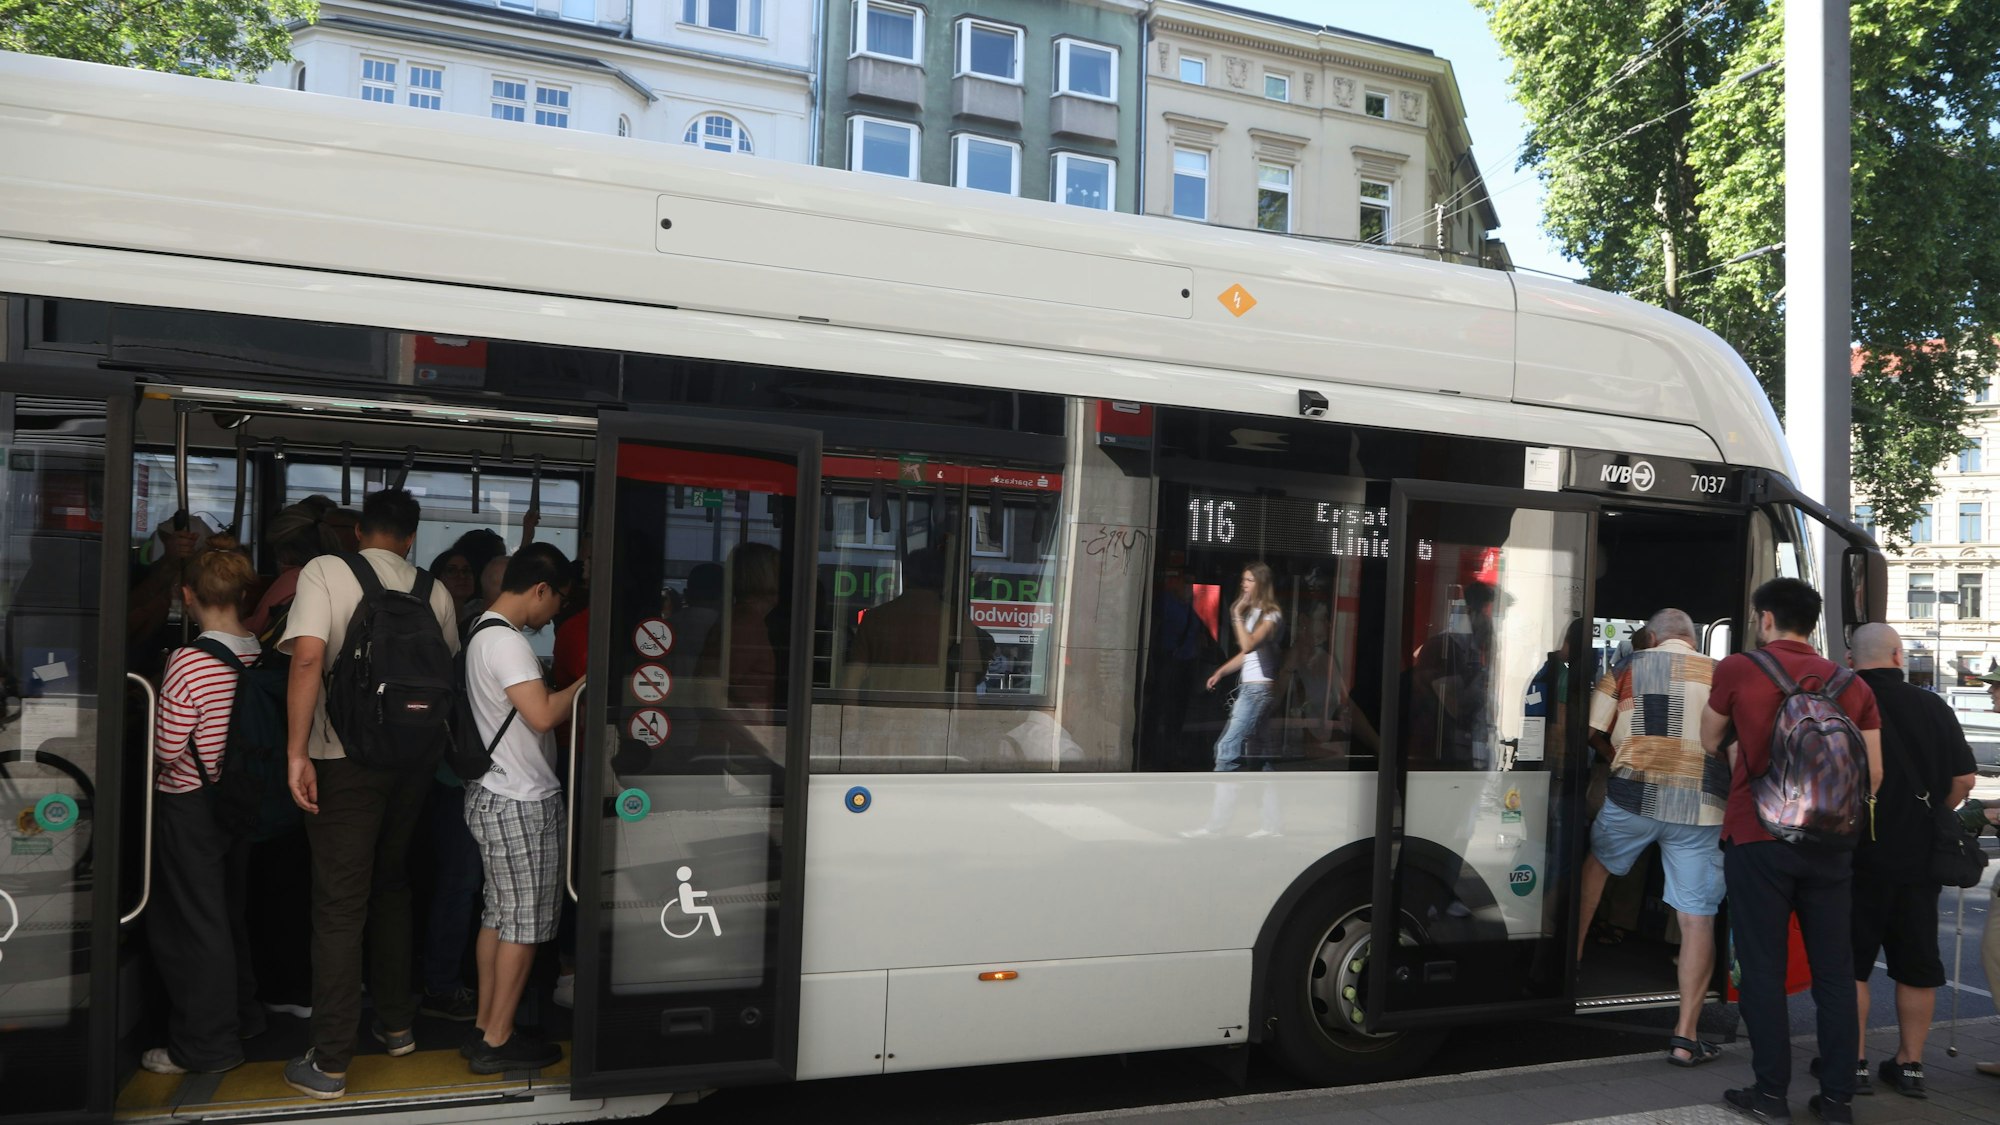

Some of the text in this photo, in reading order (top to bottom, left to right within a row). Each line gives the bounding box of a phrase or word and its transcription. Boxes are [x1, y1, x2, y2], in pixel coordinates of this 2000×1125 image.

[1600, 464, 1632, 484] KVB
[1691, 474, 1726, 494] 7037
[1189, 498, 1235, 543] 116
[1509, 871, 1530, 883] VRS
